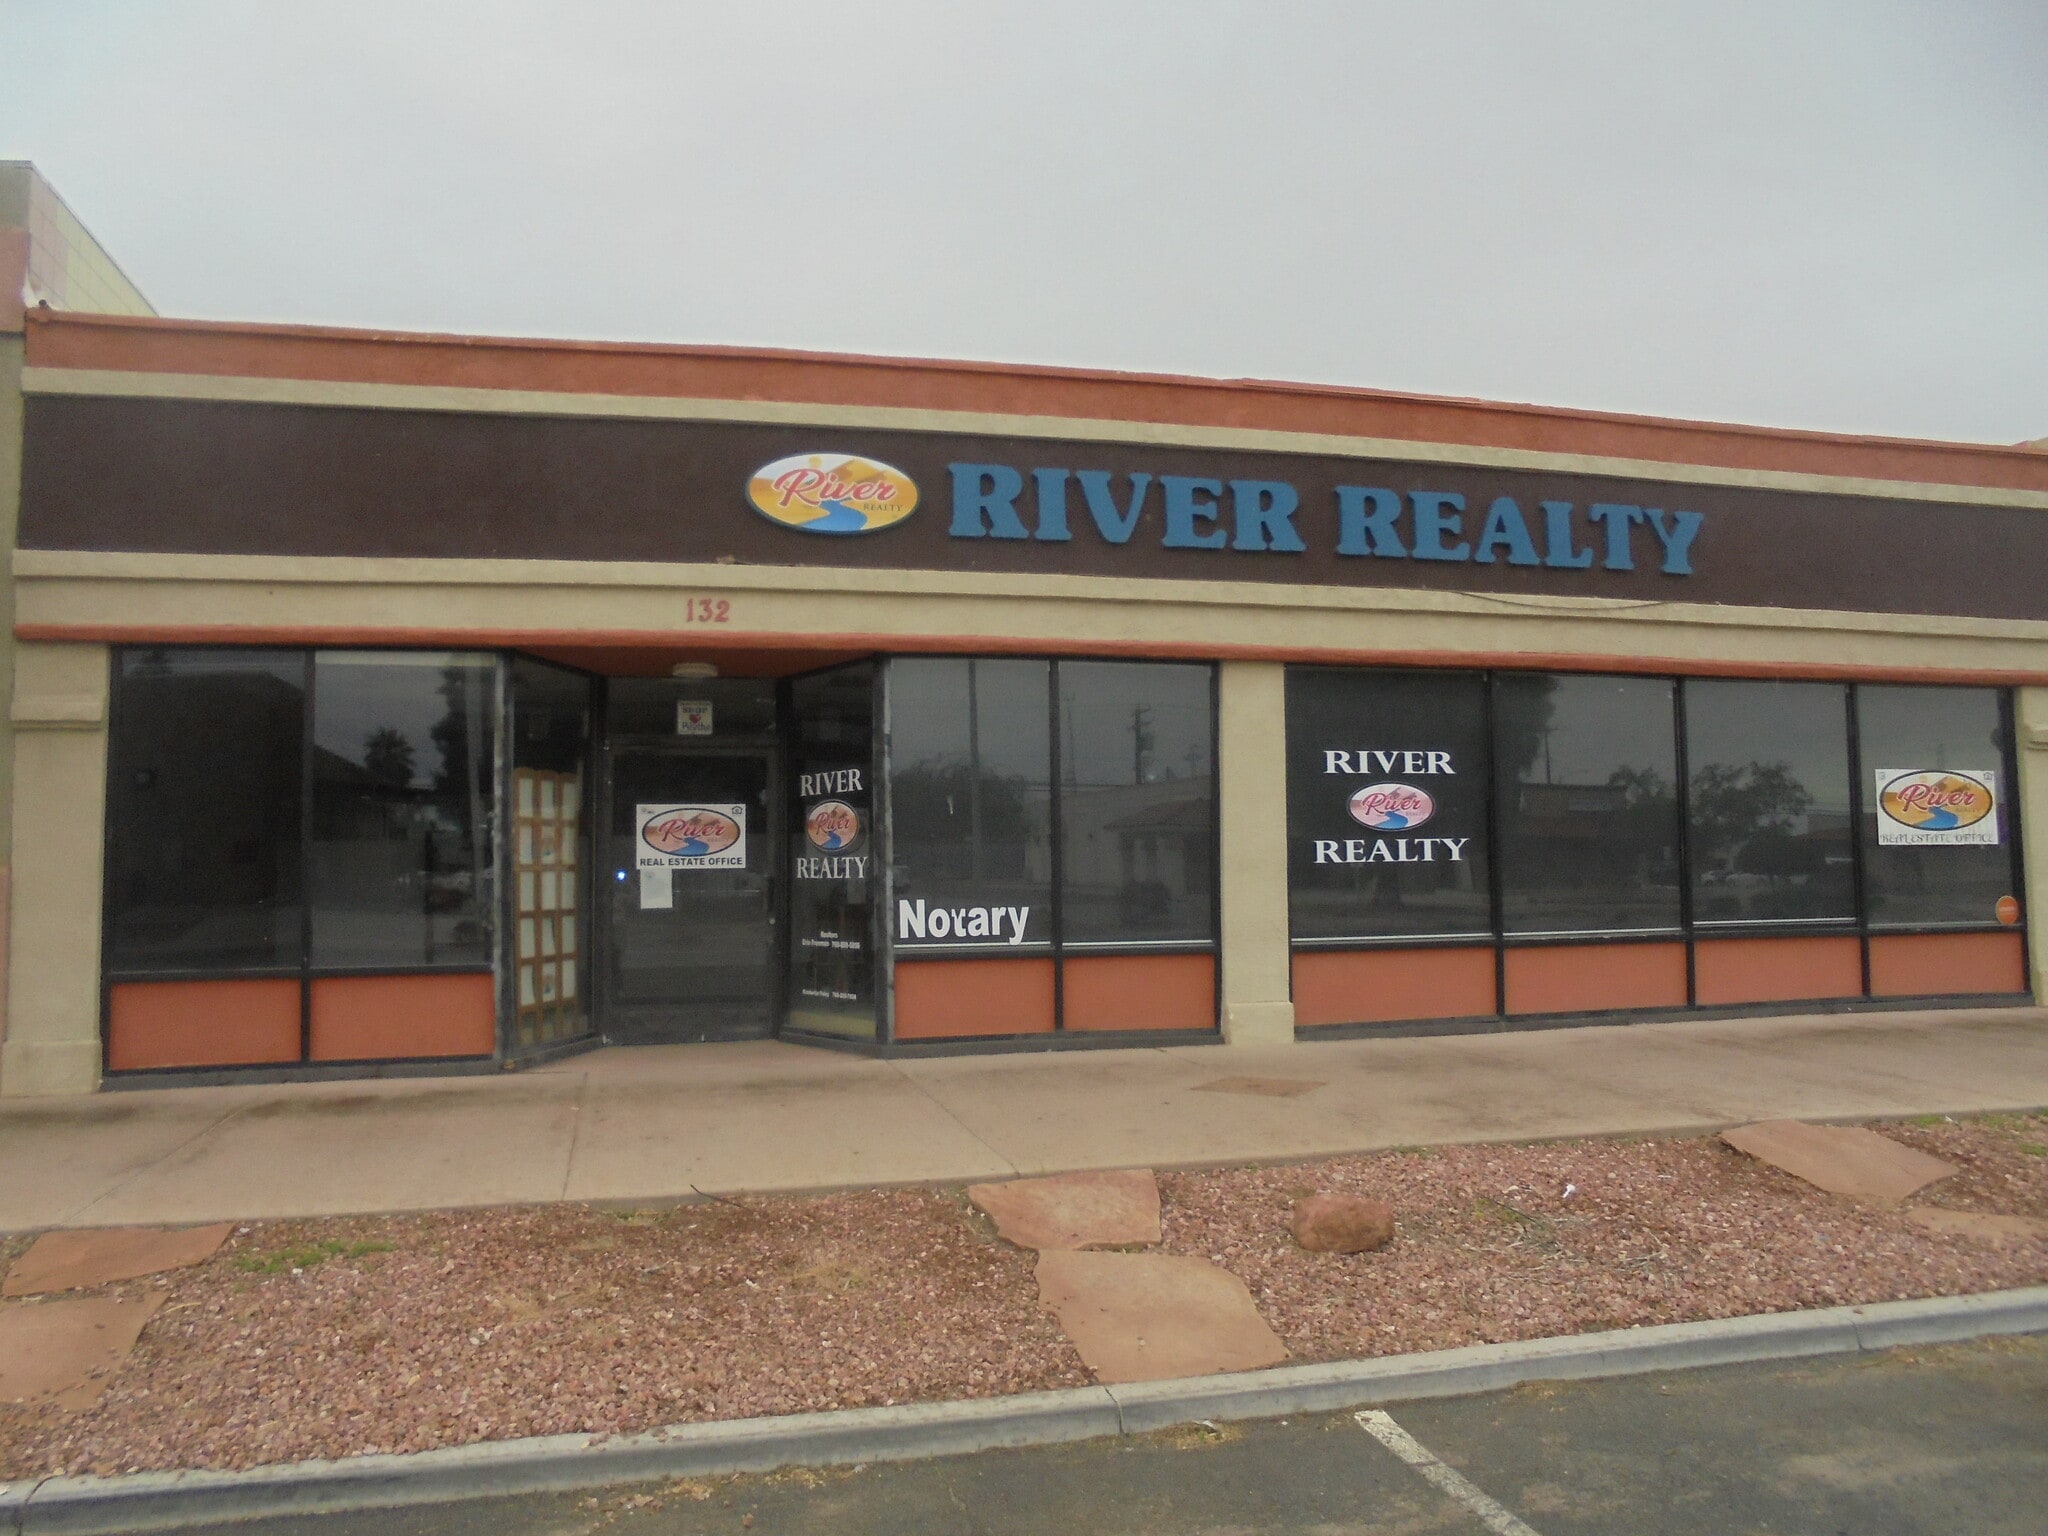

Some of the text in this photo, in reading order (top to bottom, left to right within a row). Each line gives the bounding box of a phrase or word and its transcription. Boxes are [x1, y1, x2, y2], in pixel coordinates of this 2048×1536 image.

[773, 468, 897, 507] River
[863, 503, 903, 512] REALTY
[948, 462, 1704, 576] RIVER REALTY
[686, 598, 730, 622] 132
[1323, 750, 1456, 774] RIVER
[800, 768, 863, 797] RIVER
[1362, 792, 1421, 815] River
[1897, 783, 1975, 812] River
[658, 819, 724, 842] River
[816, 811, 850, 835] River
[640, 857, 743, 866] REAL ESTATE OFFICE
[1313, 838, 1470, 864] REALTY
[797, 856, 868, 879] REALTY
[899, 899, 1030, 945] Notary
